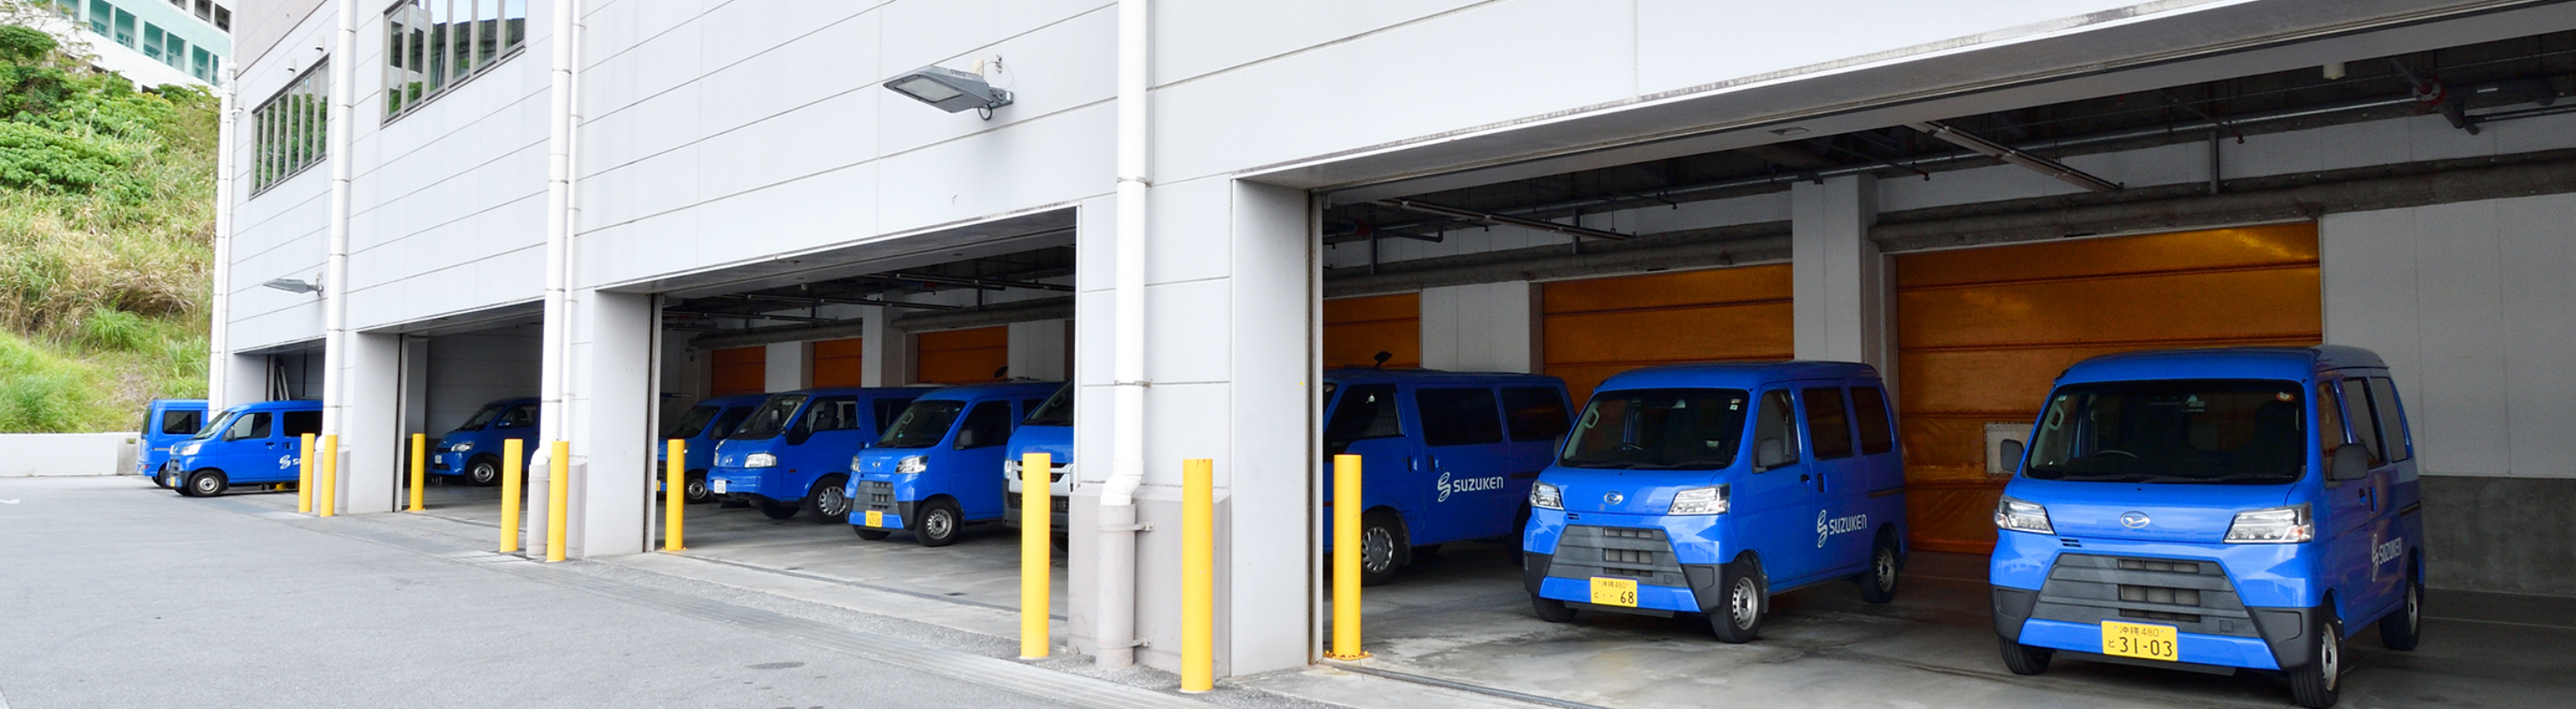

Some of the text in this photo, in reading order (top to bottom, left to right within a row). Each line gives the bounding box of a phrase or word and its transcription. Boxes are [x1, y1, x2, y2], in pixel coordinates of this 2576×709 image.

[1453, 476, 1504, 493] SUZUKEN
[1829, 514, 1868, 535] SUZUKEN
[2119, 636, 2173, 658] 31-03
